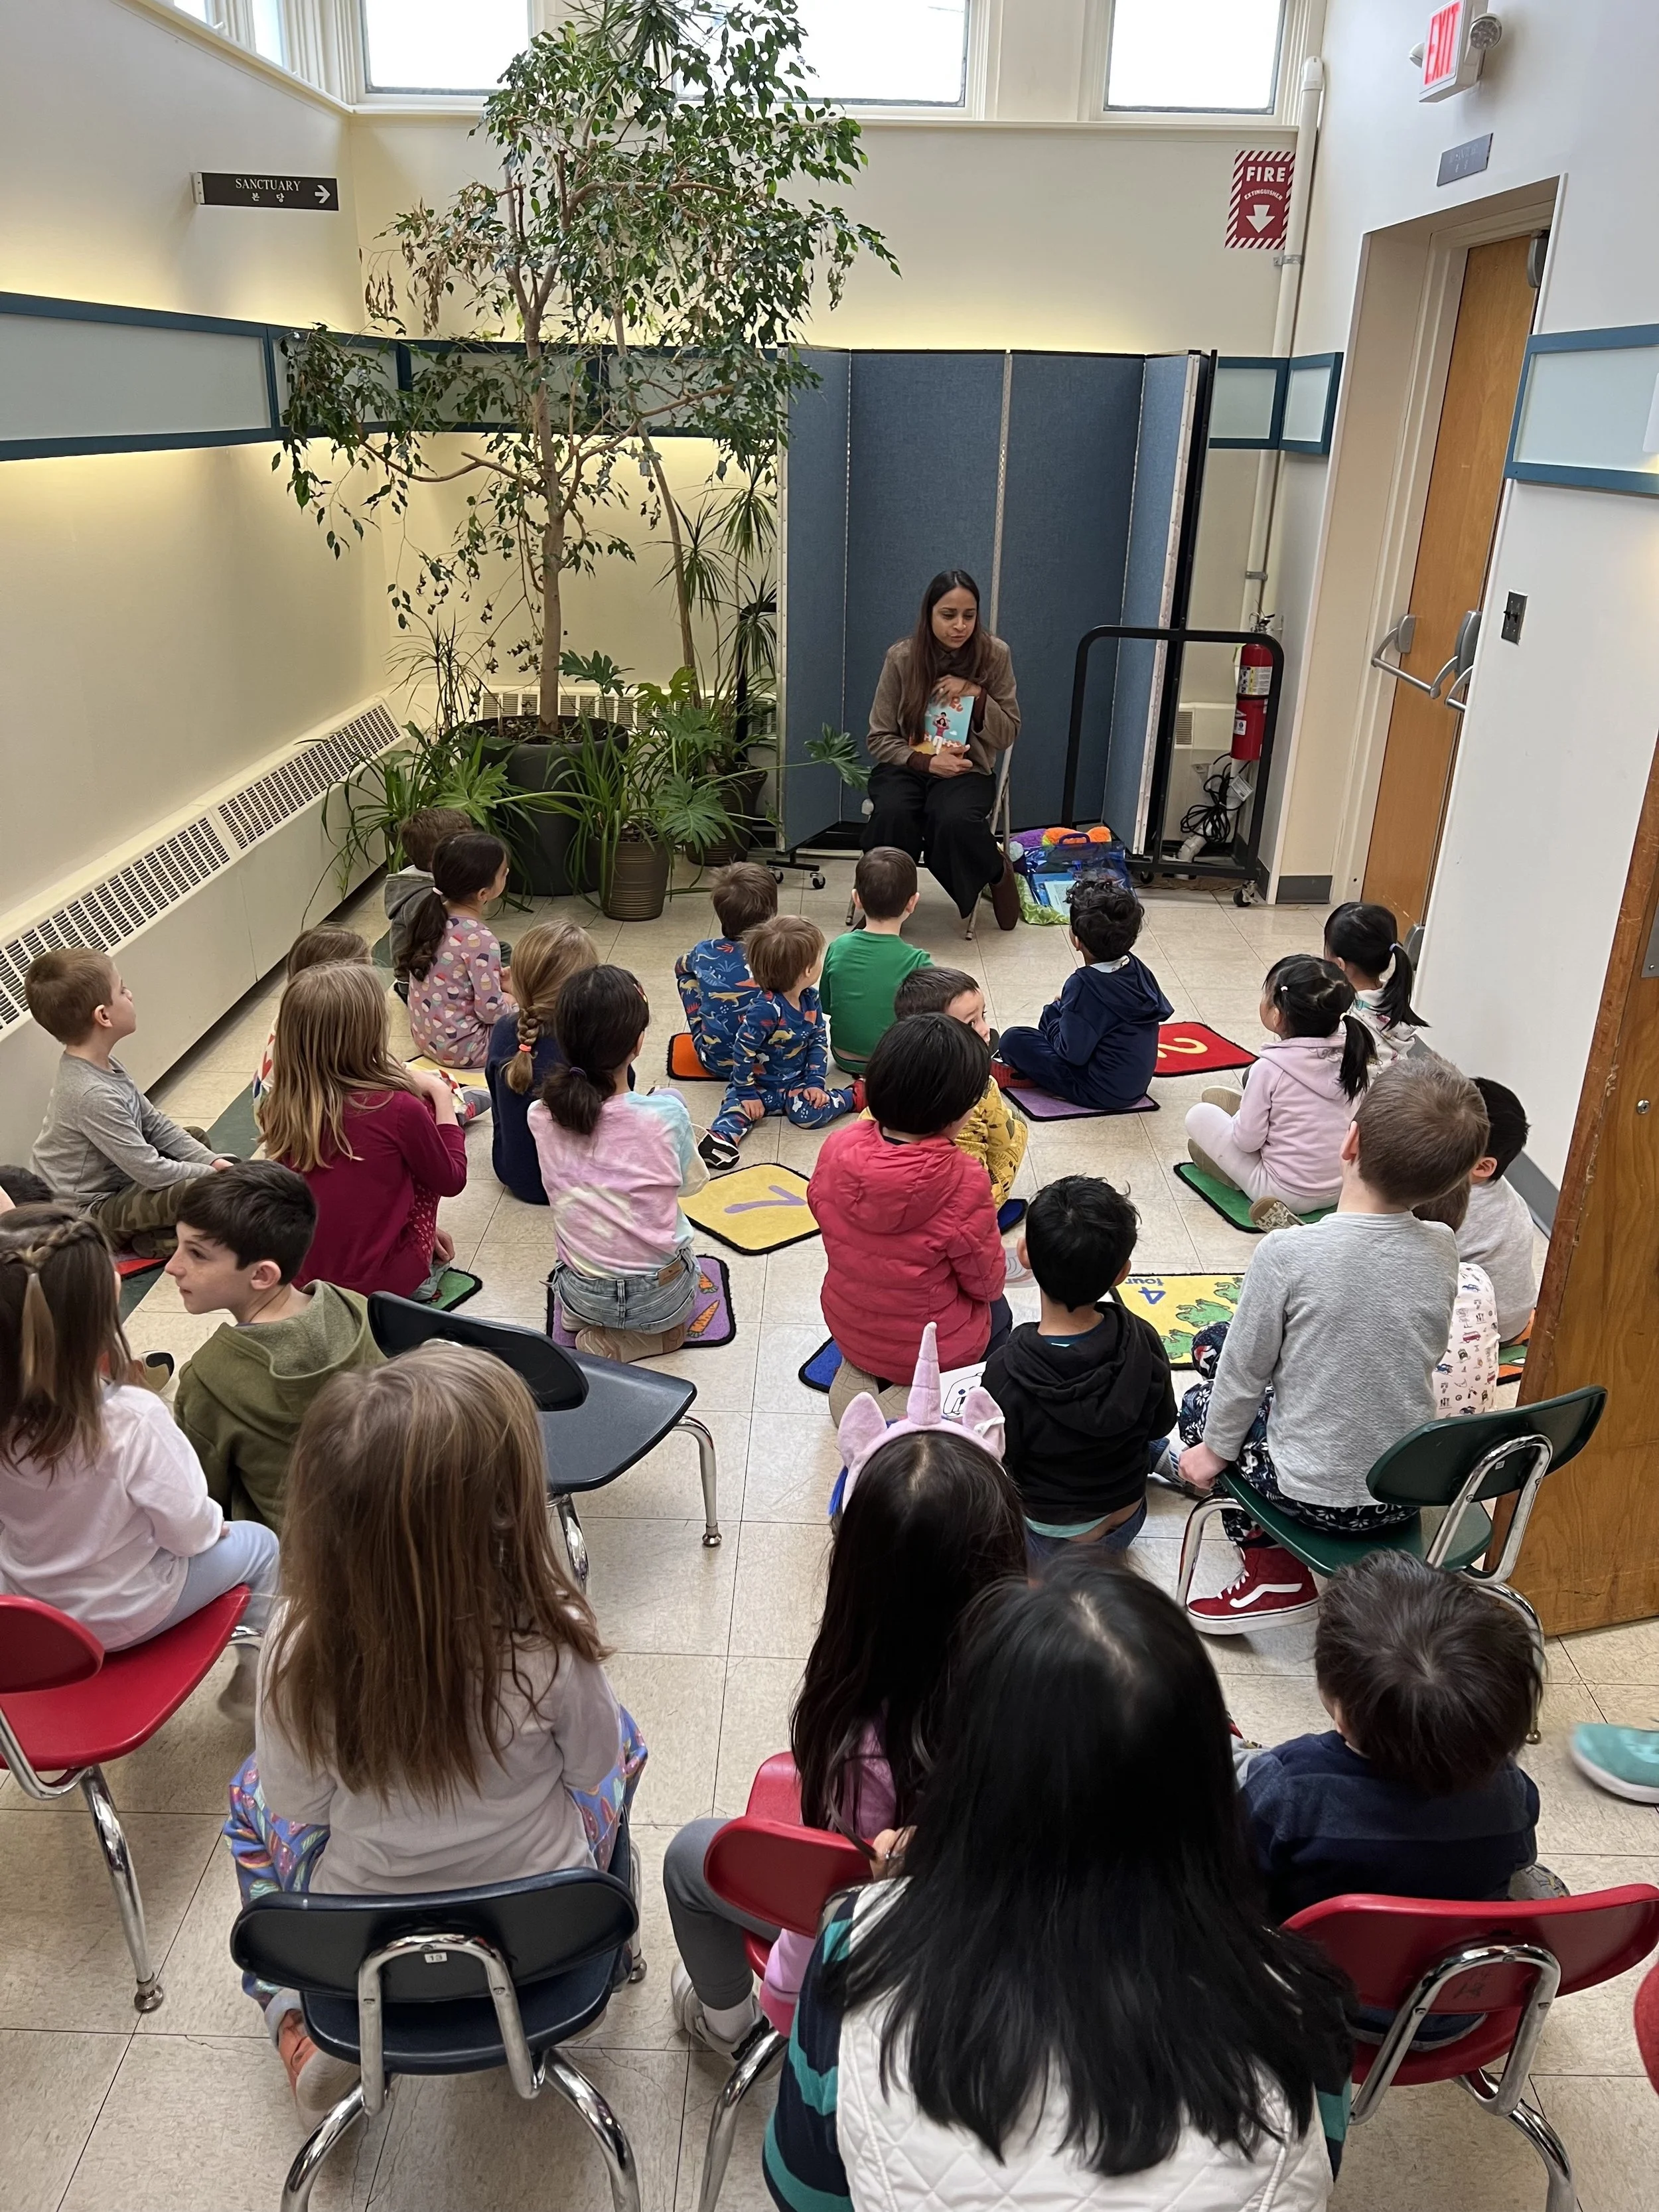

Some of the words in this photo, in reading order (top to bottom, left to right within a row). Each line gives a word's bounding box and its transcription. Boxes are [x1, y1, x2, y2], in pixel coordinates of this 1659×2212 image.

[1424, 1, 1461, 86] EXIT
[1246, 166, 1286, 183] FIRE
[235, 178, 301, 192] SANCTUARY
[1244, 188, 1283, 201] EXTINGUISHER
[1125, 1278, 1165, 1286] four
[1137, 1287, 1167, 1305] 4
